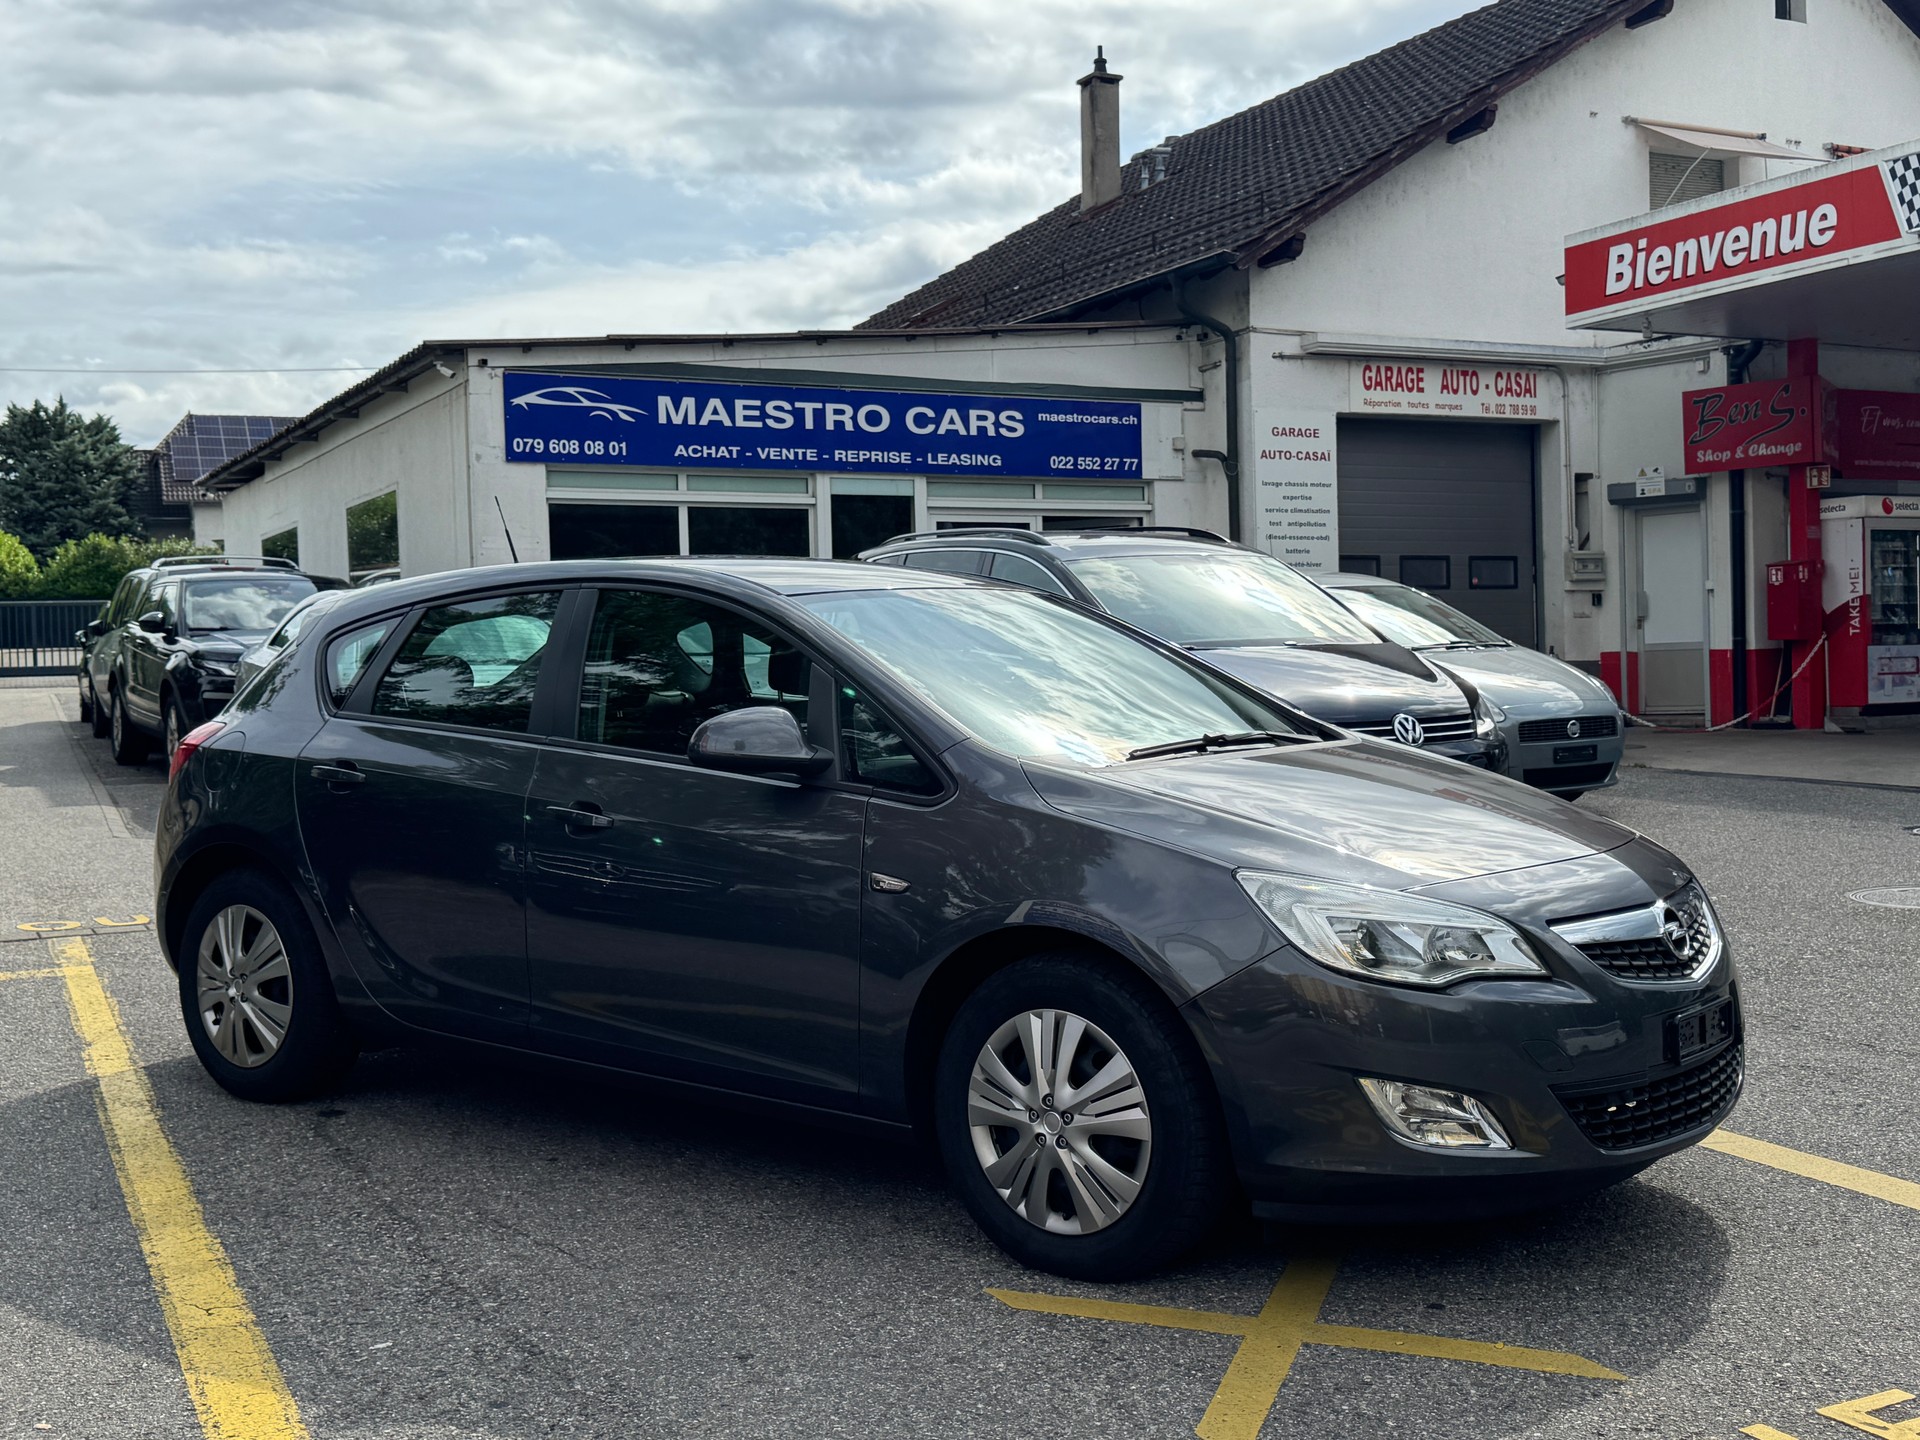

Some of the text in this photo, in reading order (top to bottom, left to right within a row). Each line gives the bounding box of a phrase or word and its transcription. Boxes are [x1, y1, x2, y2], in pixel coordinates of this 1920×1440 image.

[1605, 203, 1838, 296] Bienvenue
[1362, 364, 1425, 393] GARAGE
[1440, 369, 1480, 396] AUTO
[1363, 398, 1463, 412] Réparation toutes marques
[1495, 403, 1506, 415] 022
[1521, 405, 1528, 416] 59
[1529, 405, 1537, 416] 90
[657, 395, 1025, 438] MAESTRO CARS
[1038, 412, 1138, 425] maestrocars.ch
[1688, 392, 1761, 445] Ben
[1271, 426, 1320, 438] GARAGE
[513, 437, 627, 456] 079 608 08 01
[1697, 442, 1802, 463] Shop & Change
[674, 445, 740, 459] ACHAT
[757, 448, 818, 461] VENTE
[834, 450, 912, 464] REPRISE
[927, 453, 1002, 467] LEASING
[1260, 449, 1331, 462] AUTO-CASAÏ
[1050, 456, 1139, 471] 022 552 27 77
[1262, 480, 1283, 488] lavage
[1820, 504, 1846, 514] selecta
[1894, 502, 1919, 511] selecta
[1287, 520, 1326, 528] antipollution
[1849, 566, 1860, 637] TAKE ME!
